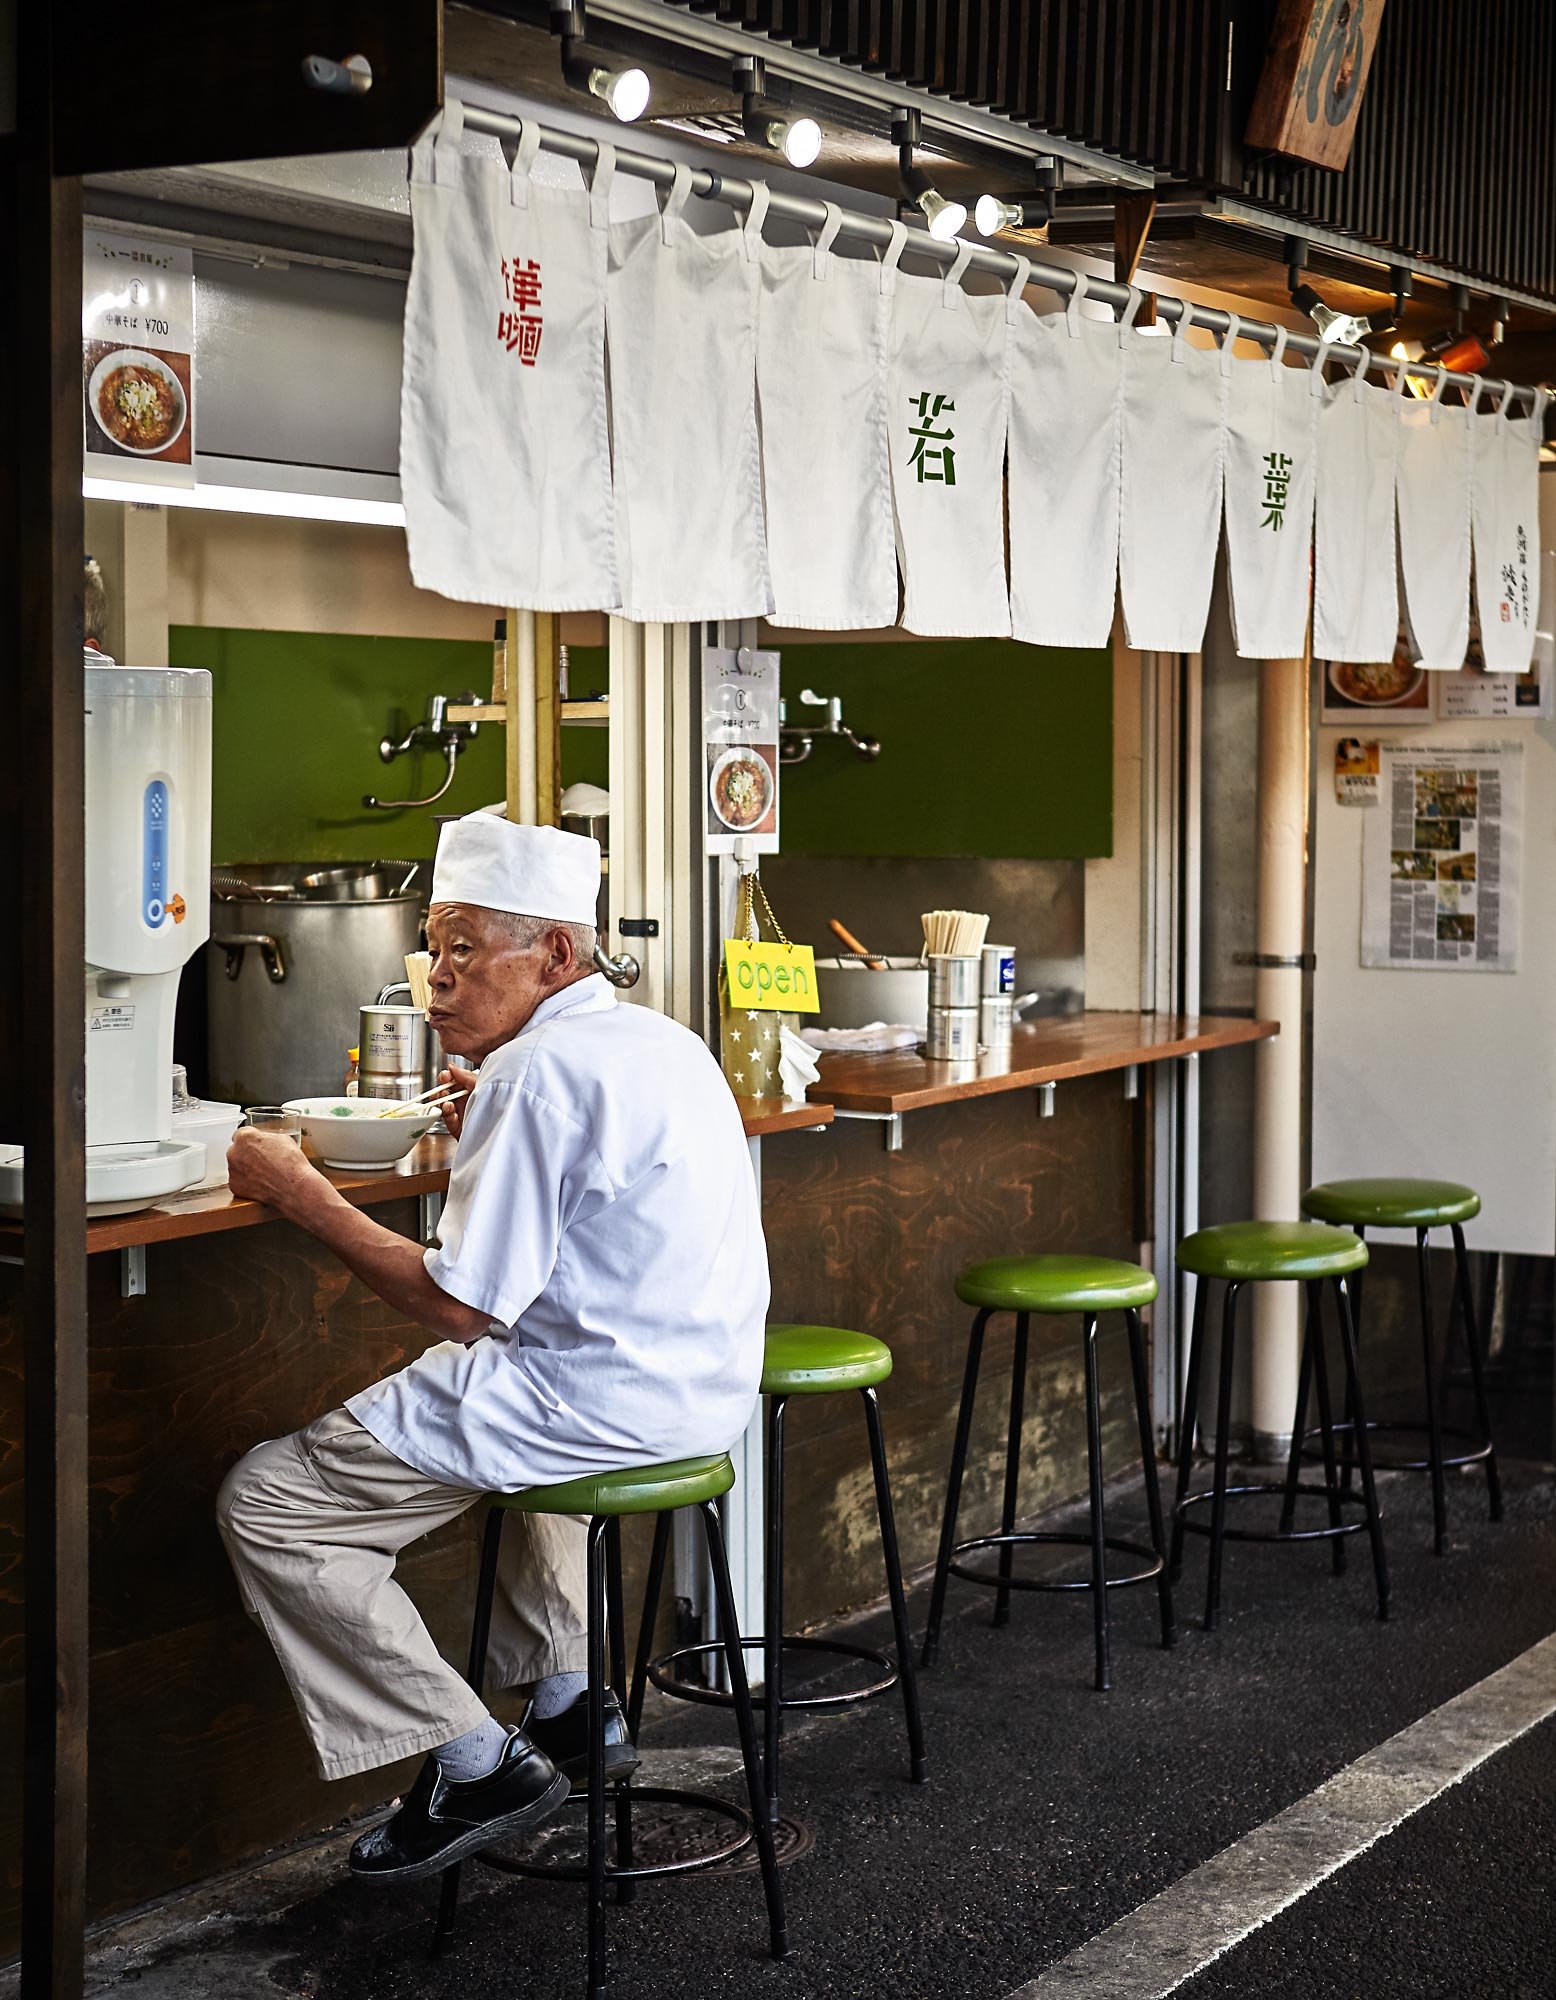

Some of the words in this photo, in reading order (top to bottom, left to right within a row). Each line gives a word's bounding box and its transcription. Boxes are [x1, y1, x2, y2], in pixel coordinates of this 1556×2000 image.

[145, 318, 169, 335] ¥700
[906, 391, 956, 486] 若
[737, 960, 808, 1001] open
